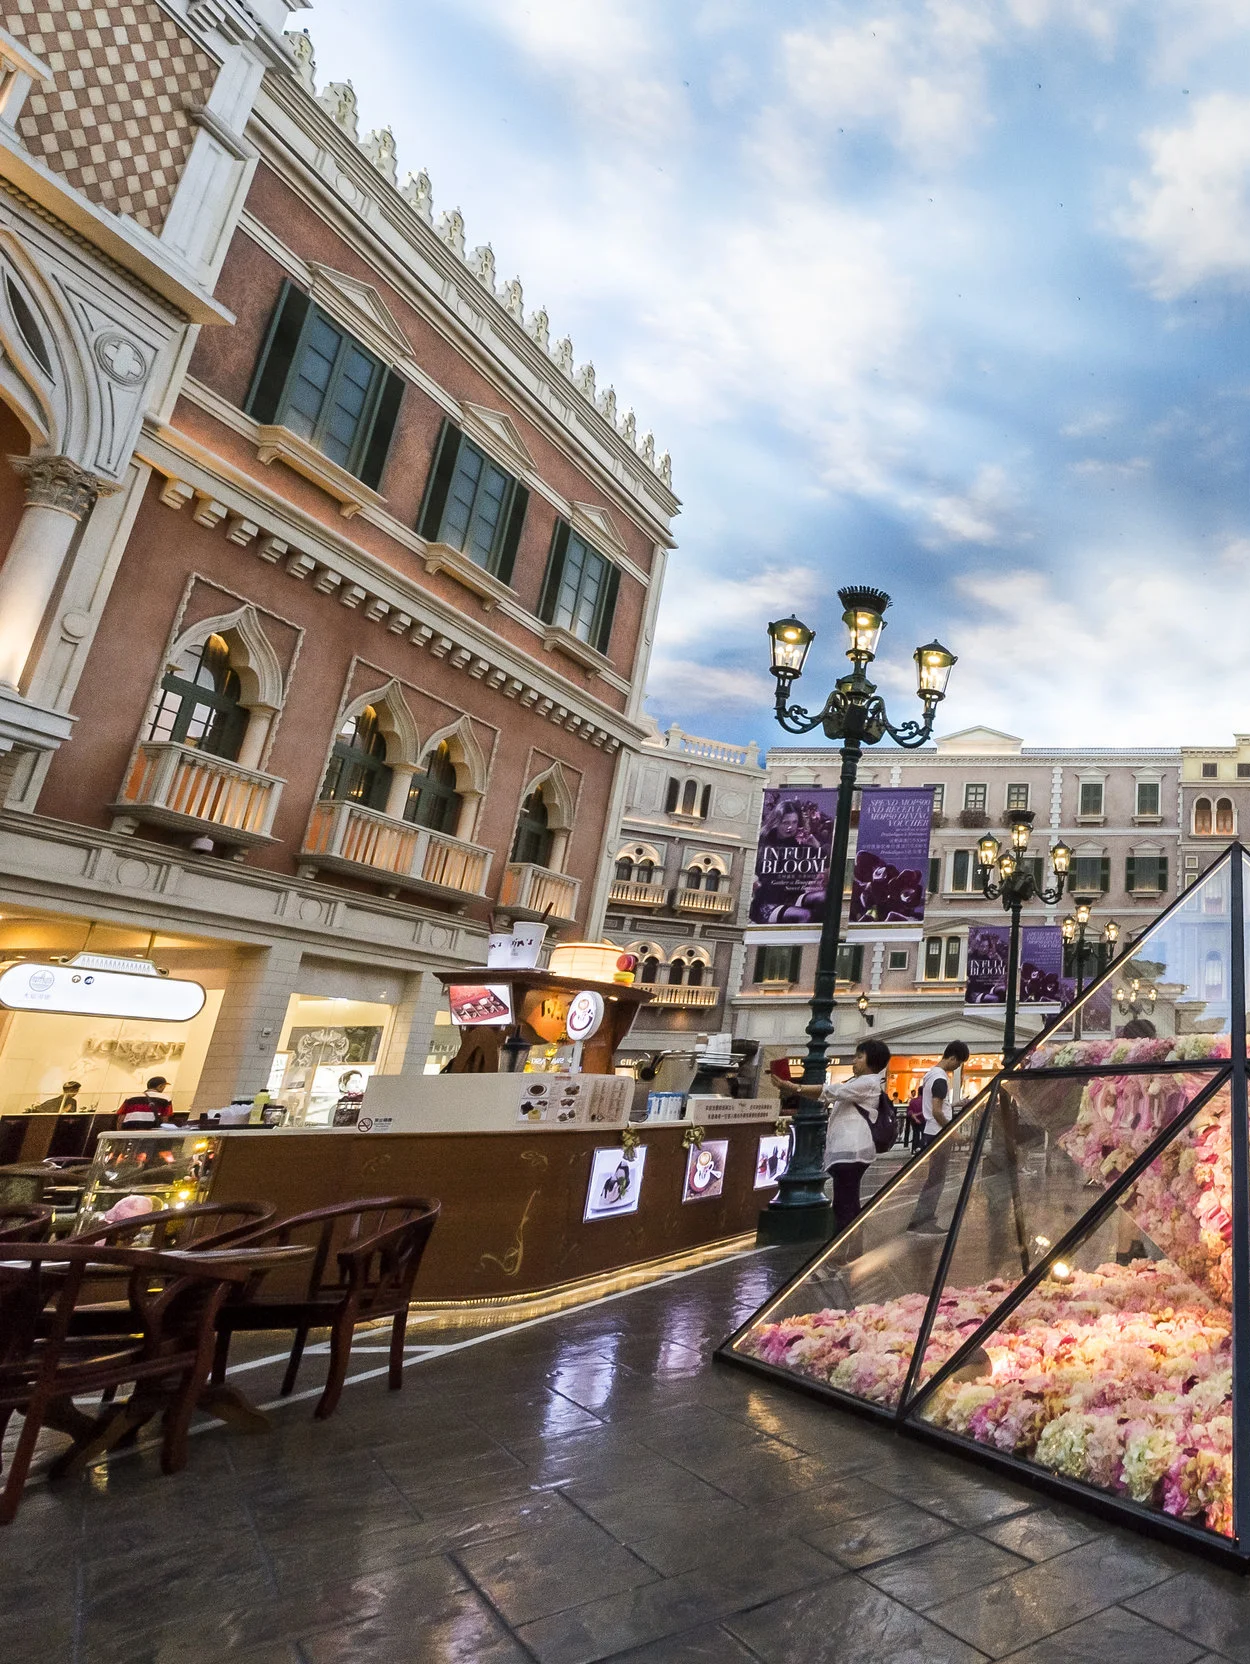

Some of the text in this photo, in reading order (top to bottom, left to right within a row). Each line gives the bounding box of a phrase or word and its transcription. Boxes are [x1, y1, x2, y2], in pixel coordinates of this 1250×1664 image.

[763, 846, 827, 860] IN FULL
[761, 859, 826, 874] BLOOM
[970, 966, 1006, 976] BLOOM
